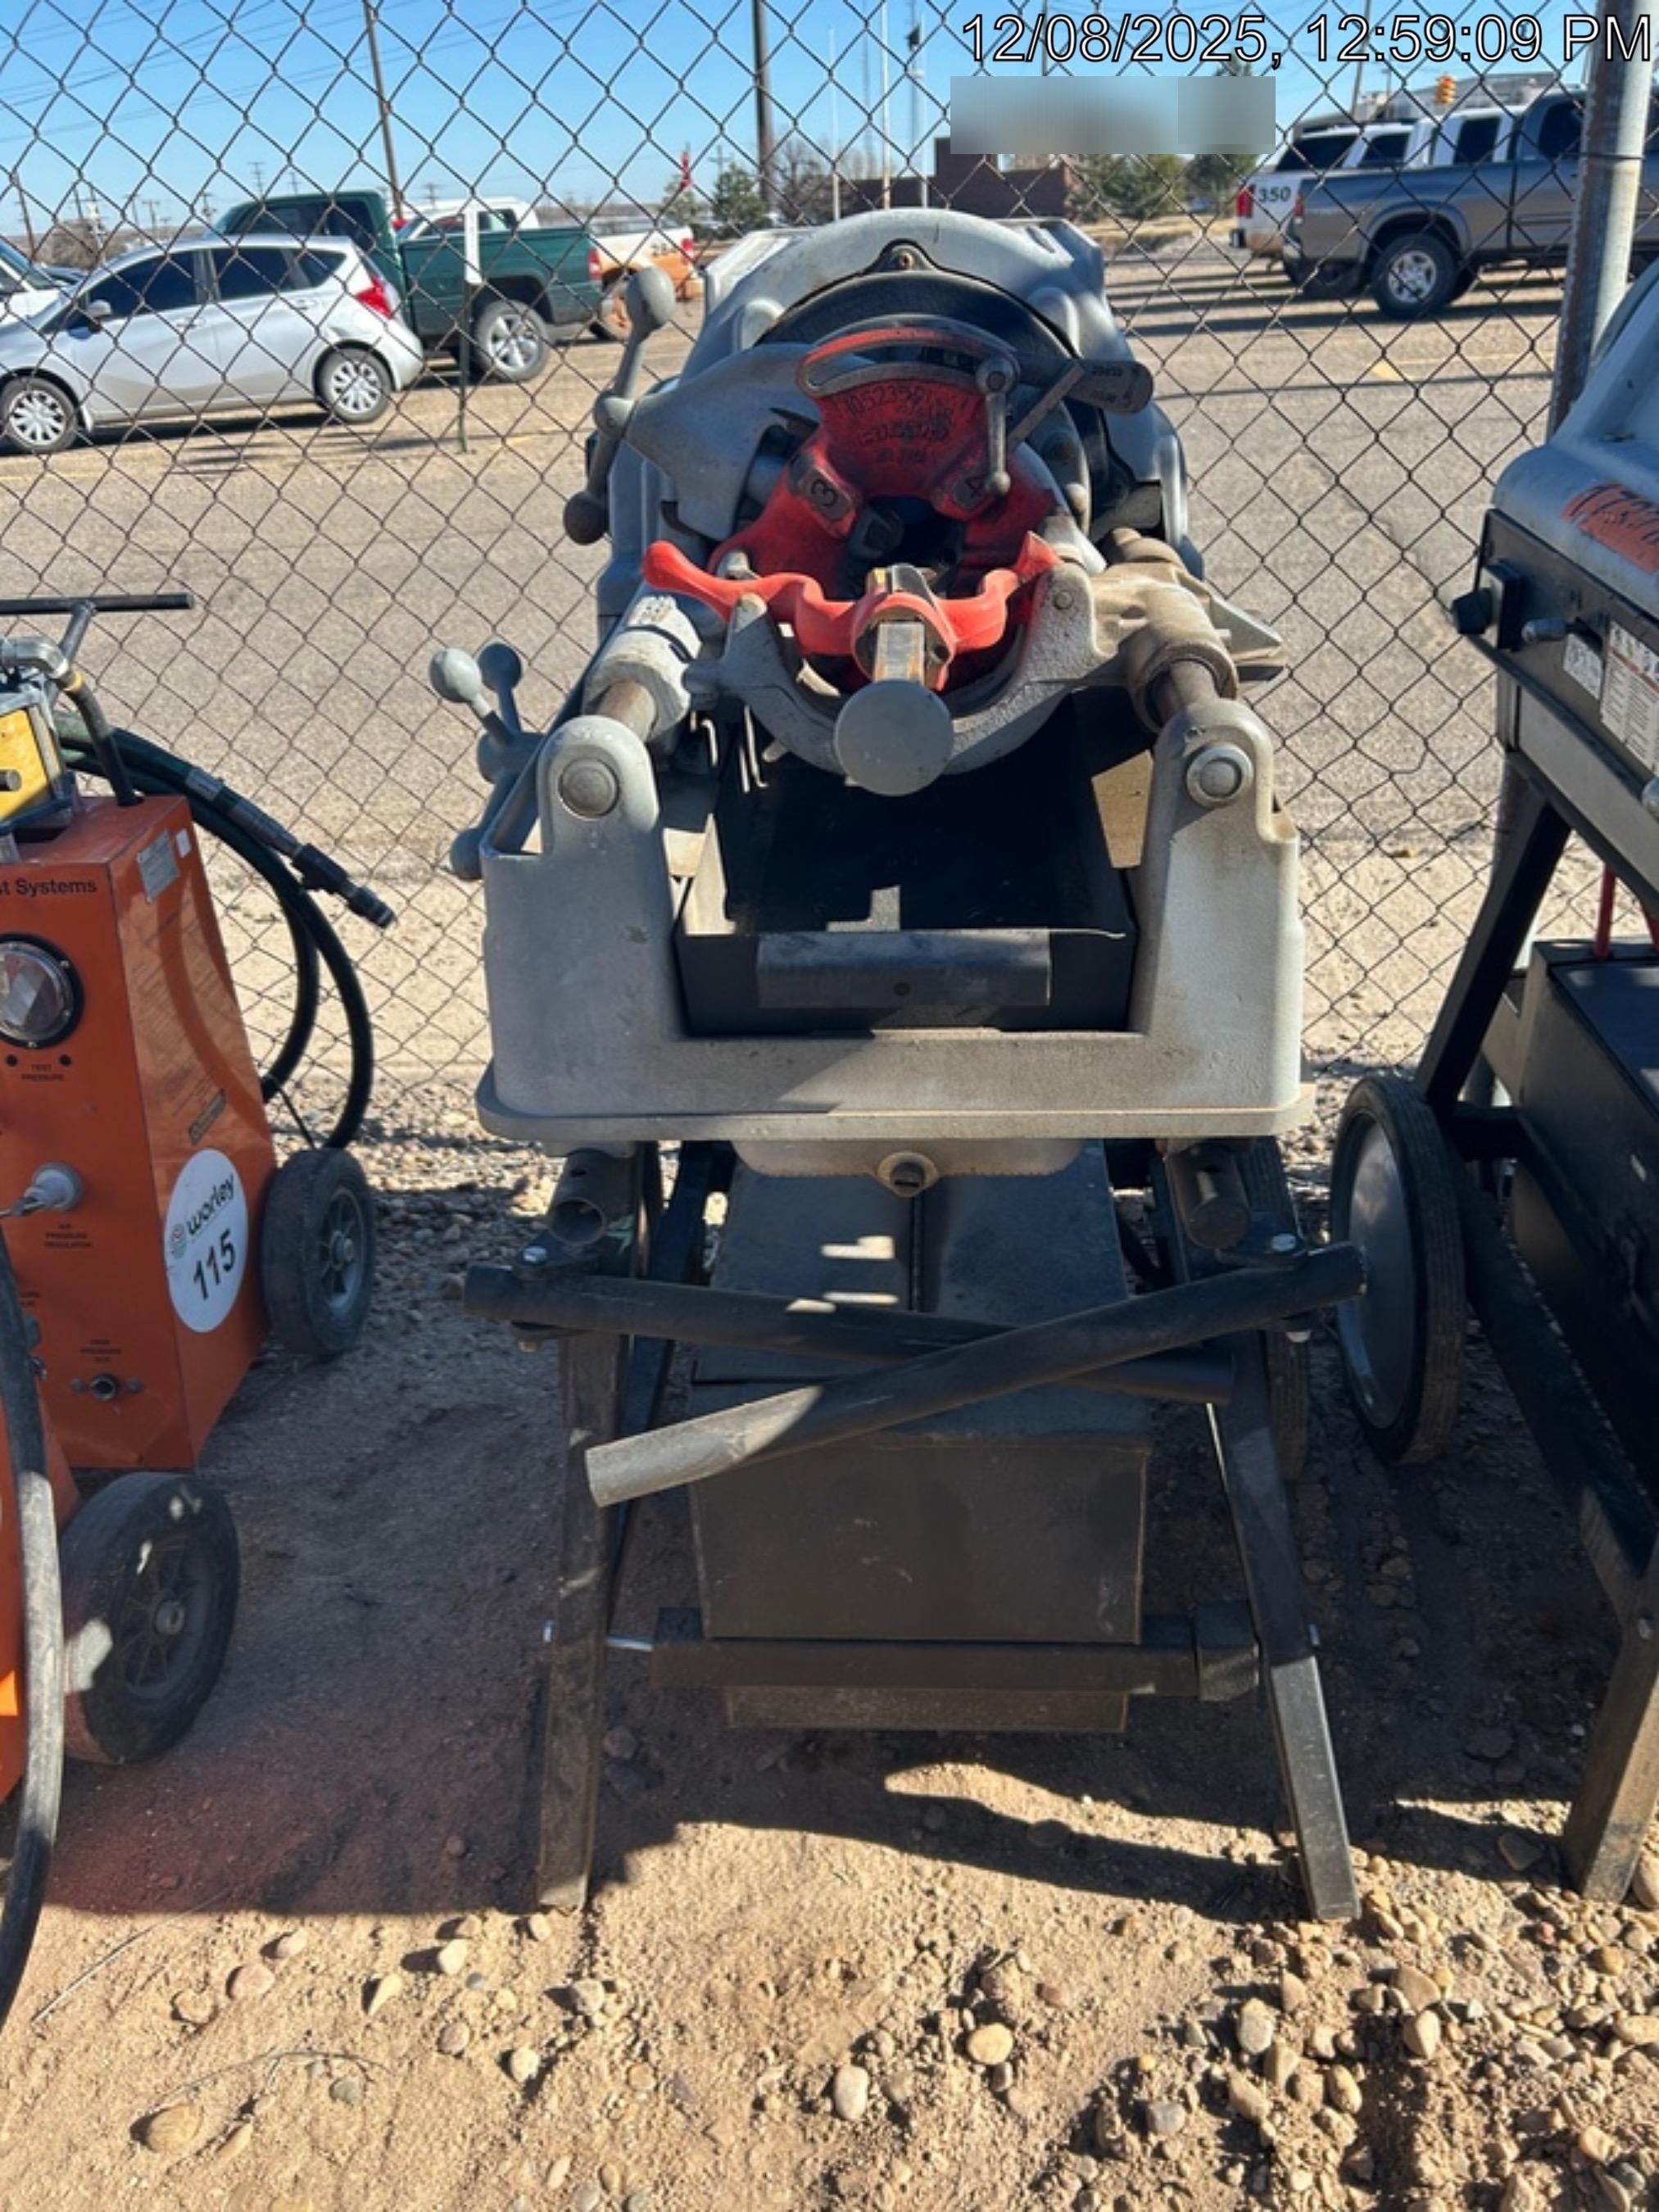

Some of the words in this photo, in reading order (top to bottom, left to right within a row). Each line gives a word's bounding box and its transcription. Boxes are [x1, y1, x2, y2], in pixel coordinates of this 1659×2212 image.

[1258, 186, 1292, 203] 350
[810, 478, 839, 506] 3
[16, 877, 98, 898] Systems
[193, 1227, 236, 1301] 115
